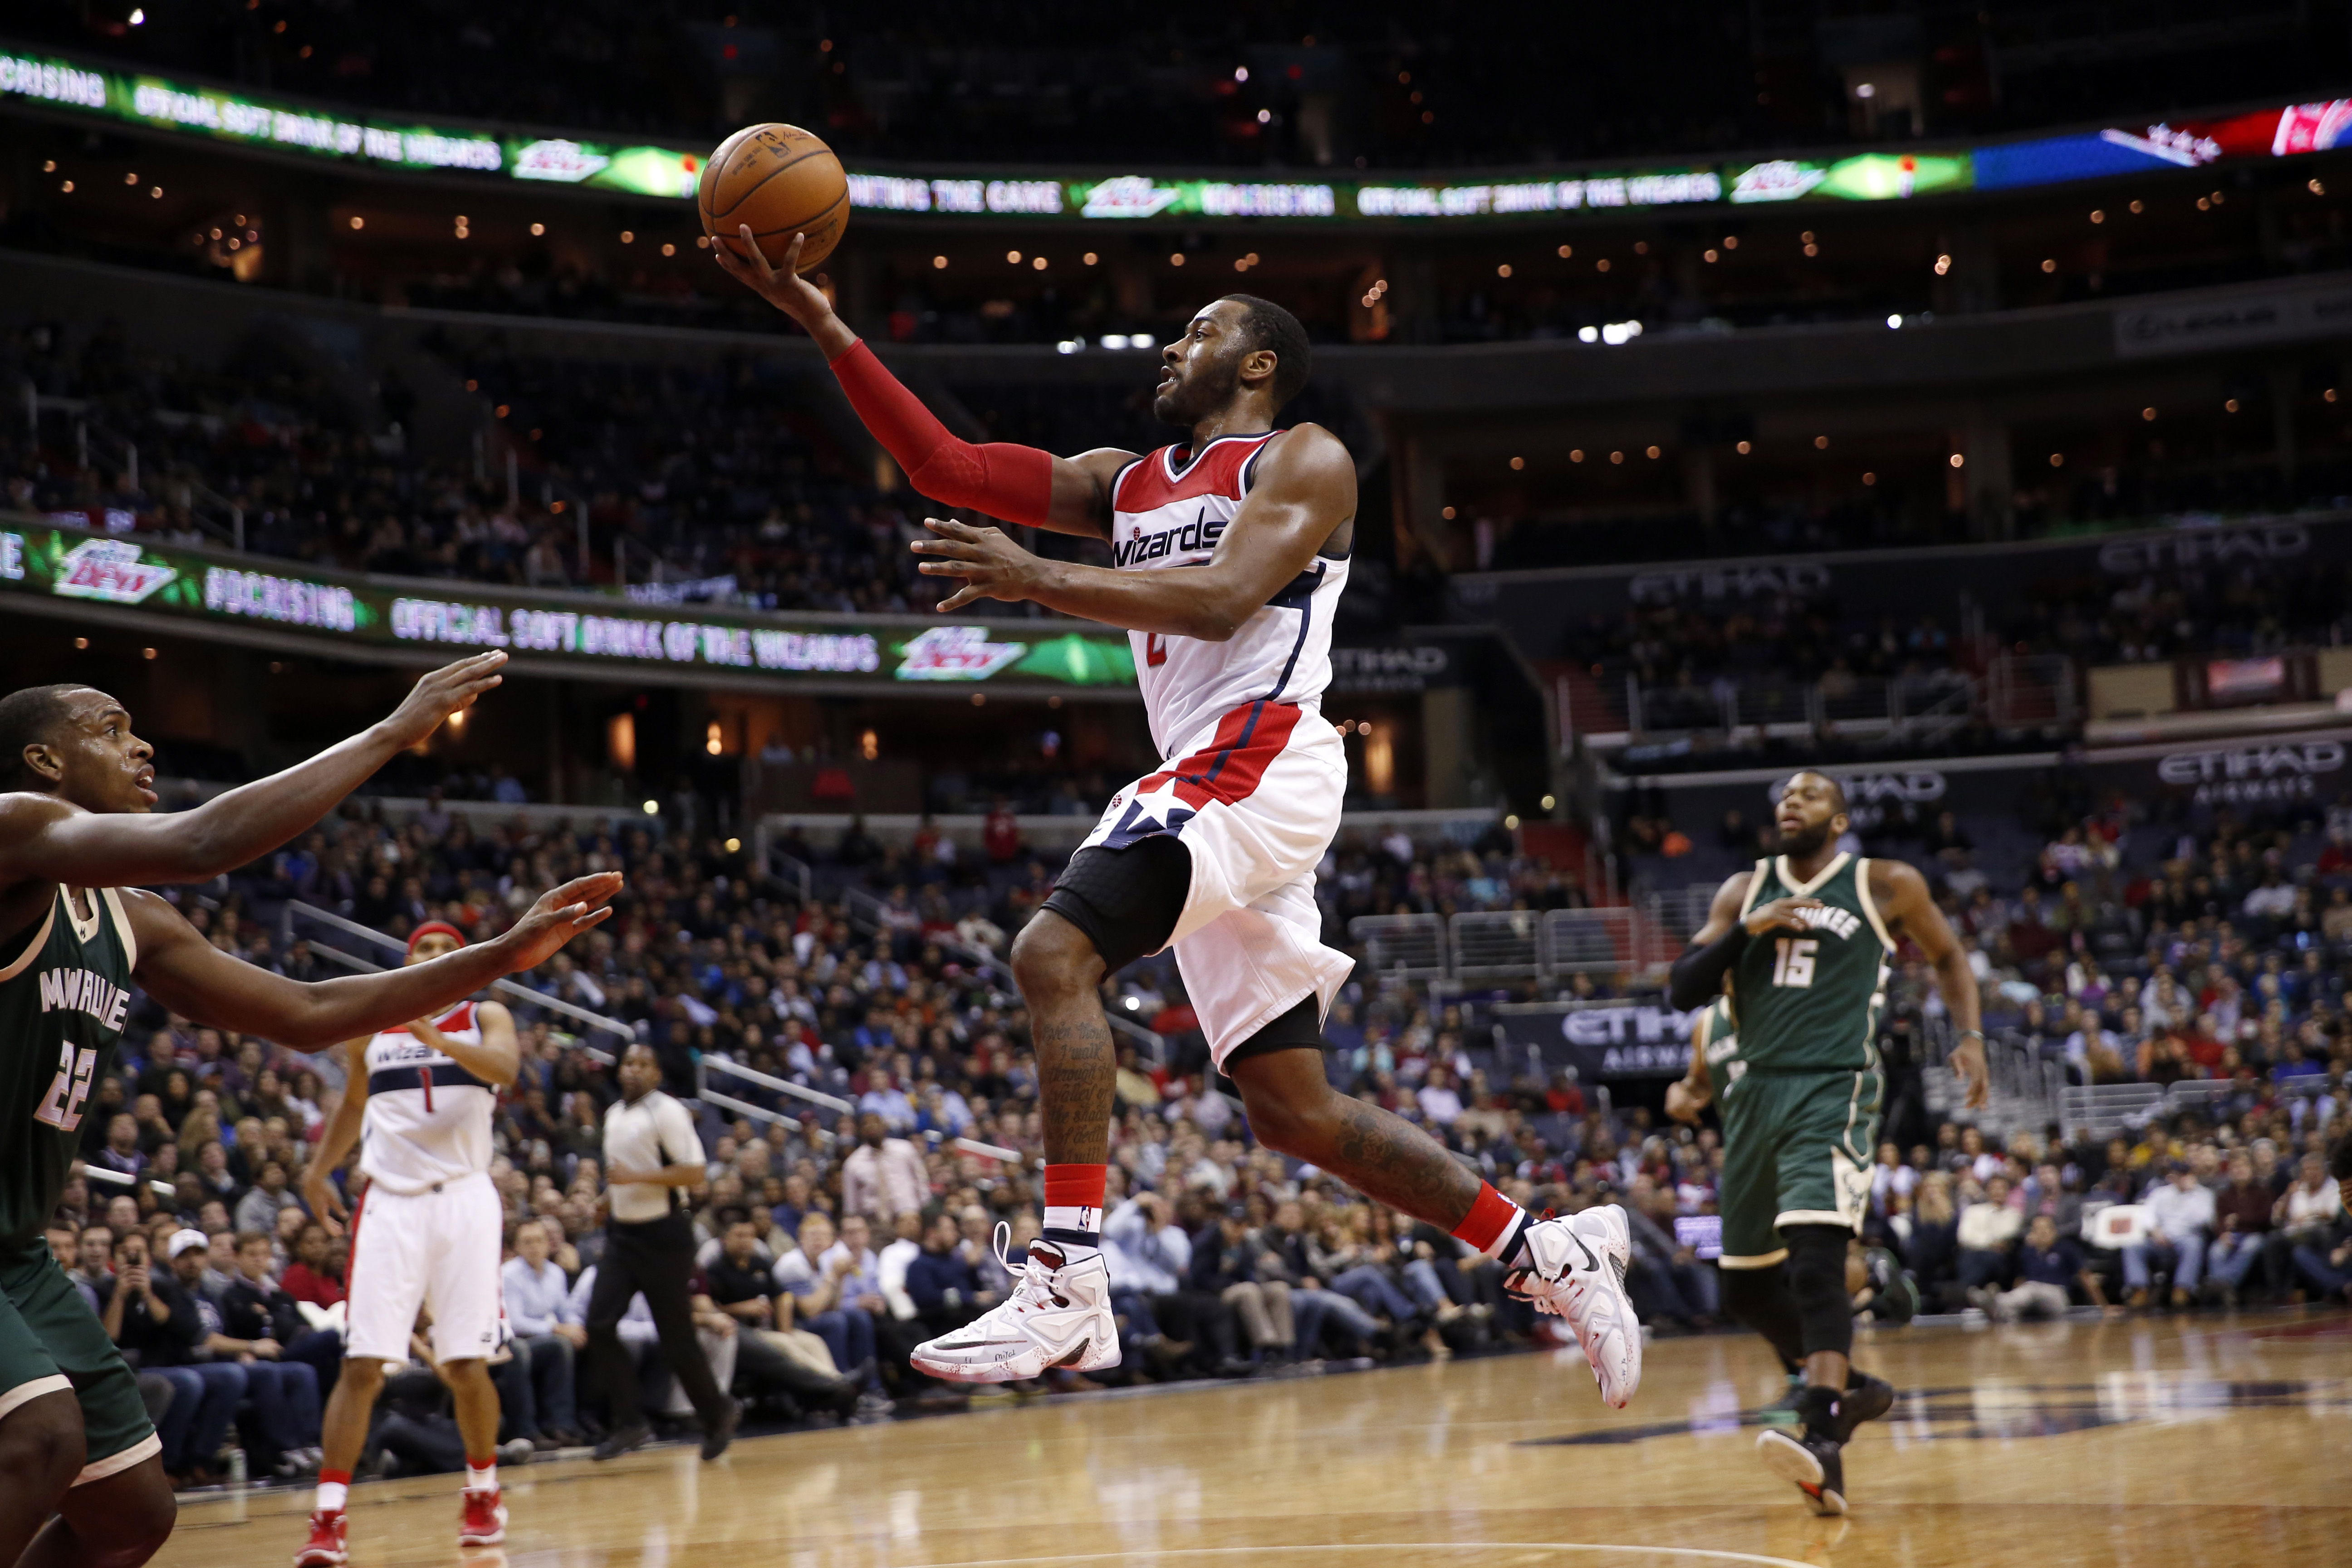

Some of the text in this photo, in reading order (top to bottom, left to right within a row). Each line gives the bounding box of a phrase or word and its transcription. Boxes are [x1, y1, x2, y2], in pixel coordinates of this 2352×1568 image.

[2158, 740, 2345, 784] ETIHAD
[1773, 938, 1819, 989] 15
[33, 1039, 97, 1132] 22
[418, 1067, 434, 1113] 1
